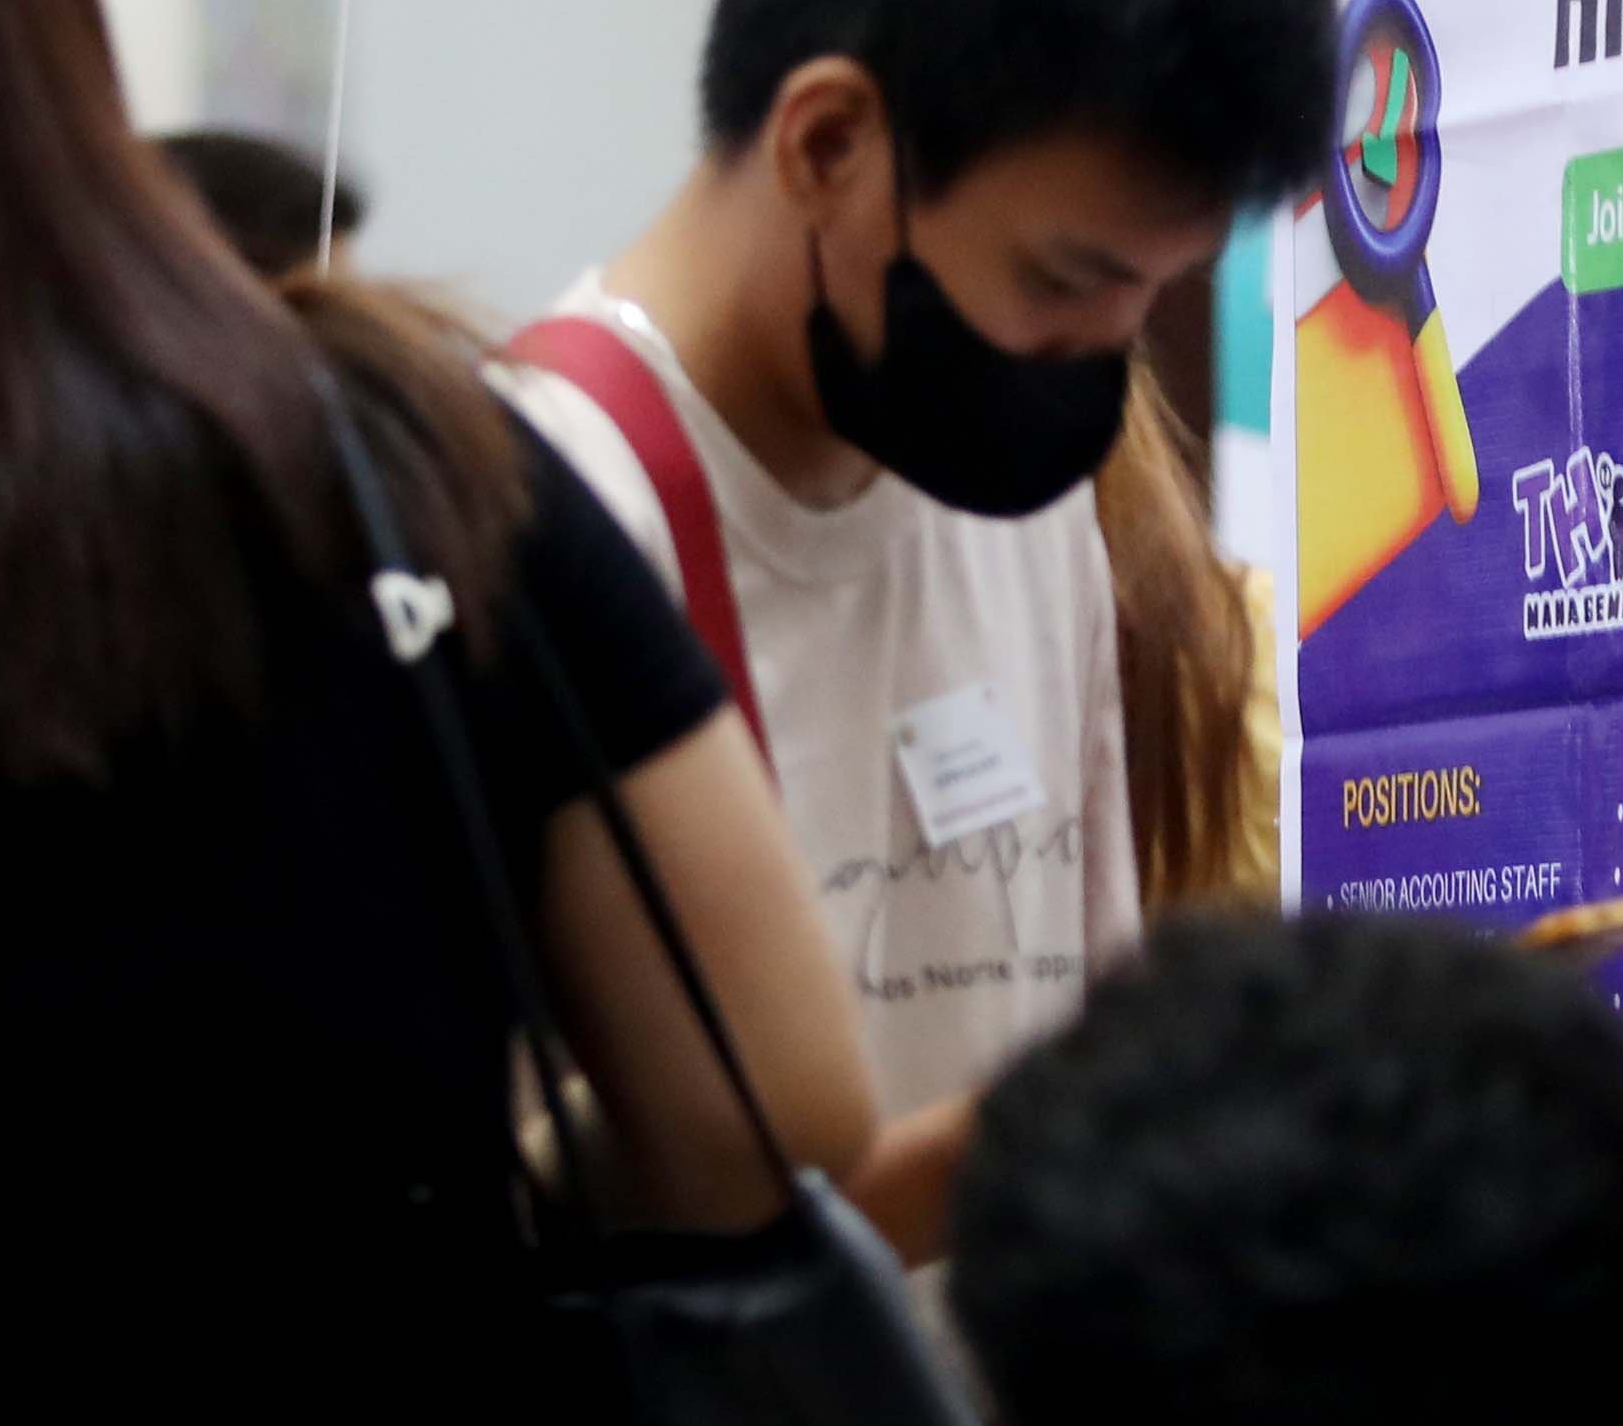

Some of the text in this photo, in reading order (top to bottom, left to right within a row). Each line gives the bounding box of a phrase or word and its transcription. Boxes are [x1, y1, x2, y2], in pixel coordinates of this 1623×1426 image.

[1343, 764, 1482, 830] POSITIONS:
[1340, 862, 1562, 912] SENIOR ACCOUTING STAFF
